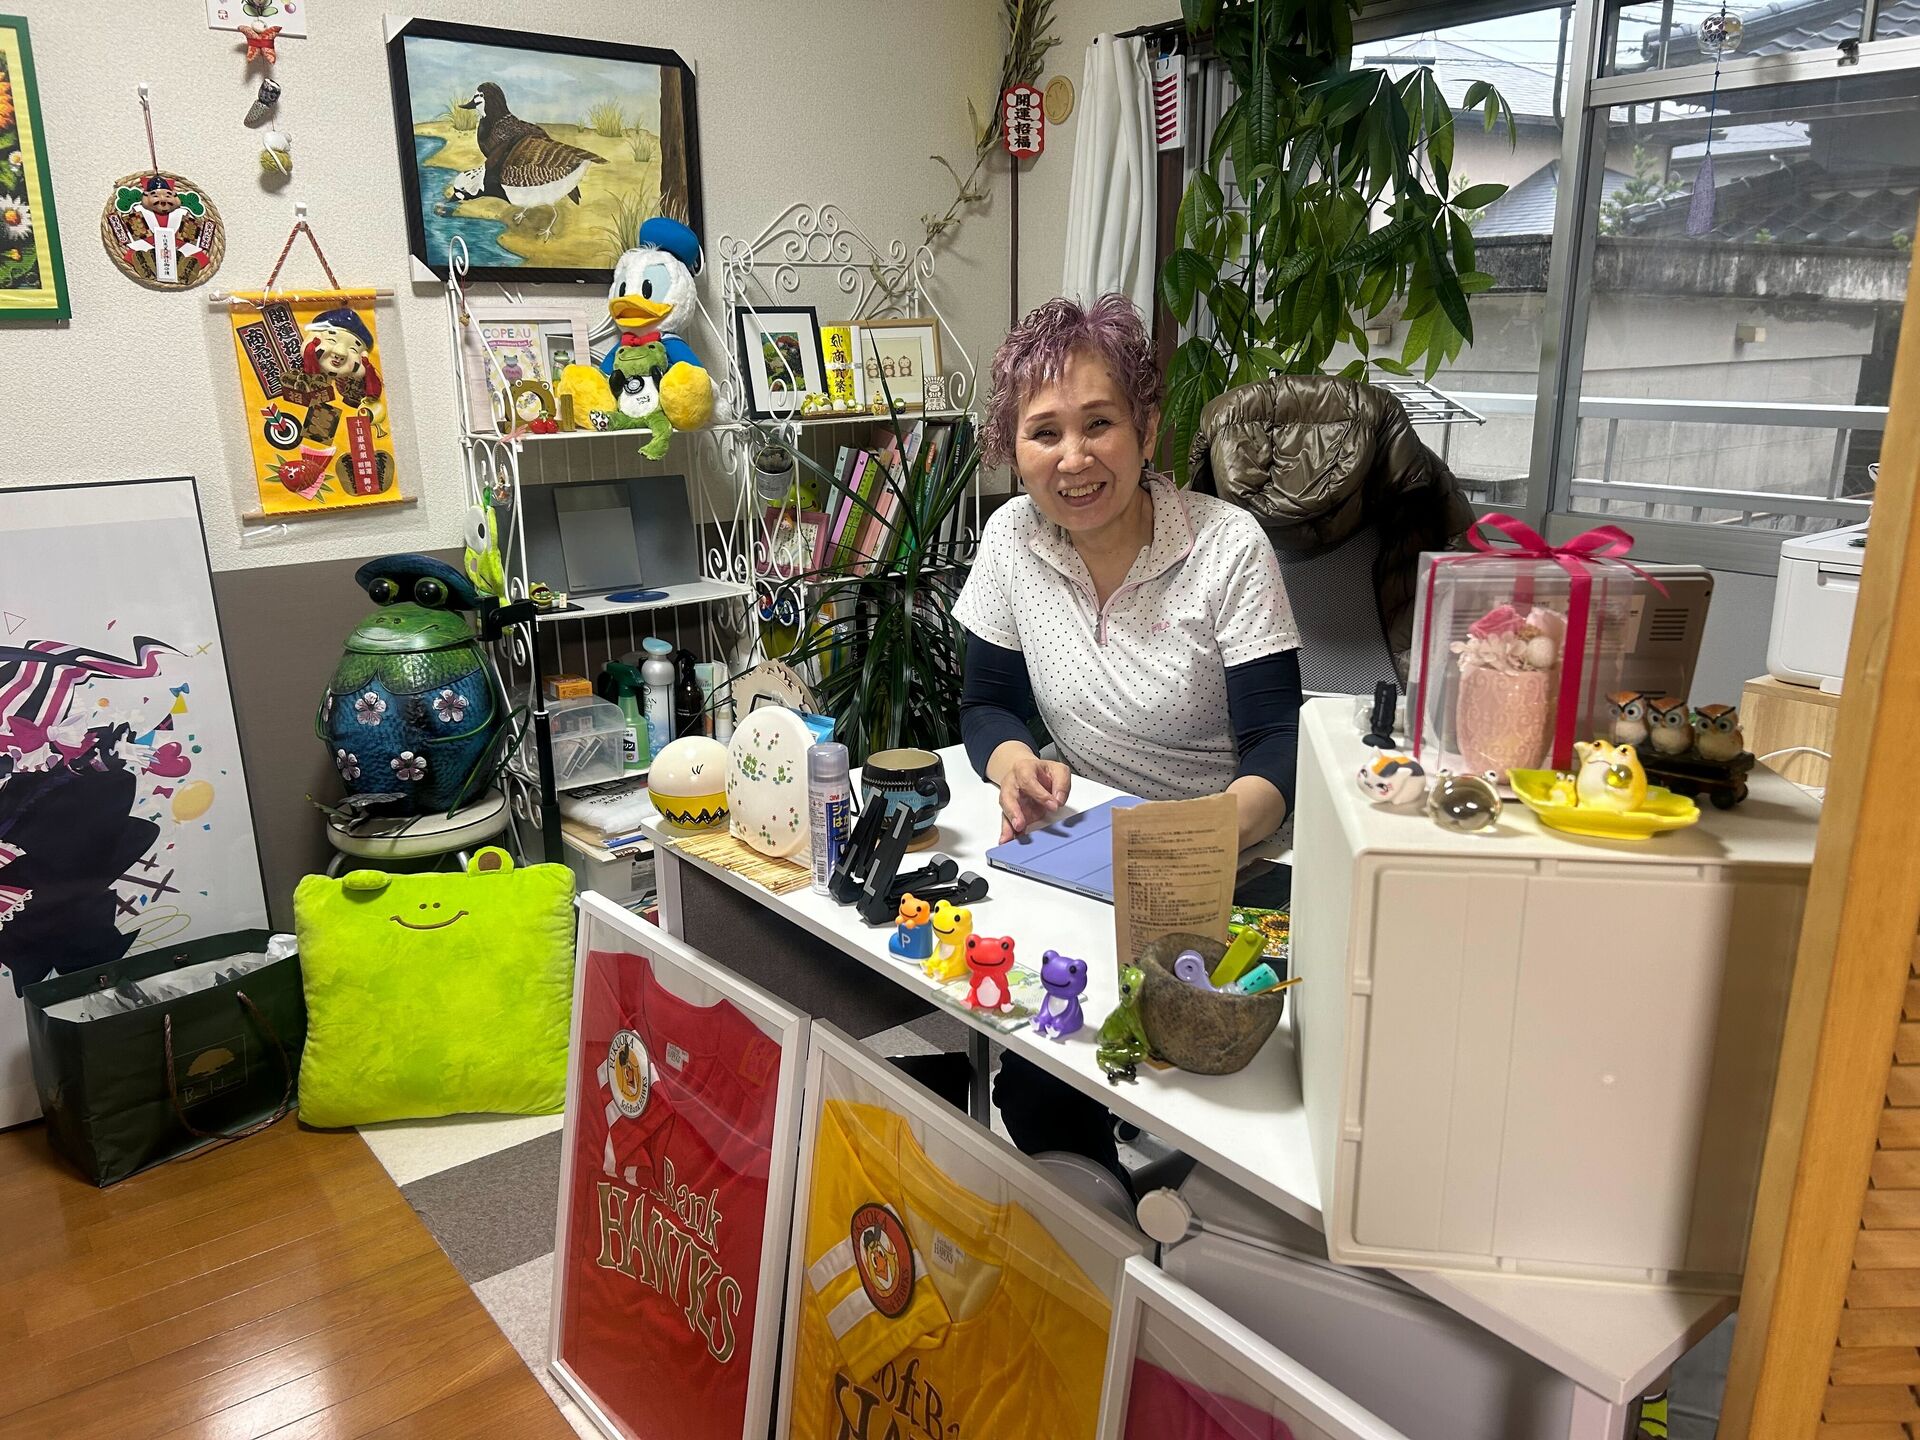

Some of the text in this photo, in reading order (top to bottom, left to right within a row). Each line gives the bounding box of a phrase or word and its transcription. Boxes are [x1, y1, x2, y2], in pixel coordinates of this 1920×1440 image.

[1014, 93, 1034, 148] 開運招福
[482, 328, 531, 339] COPEAU
[901, 933, 911, 948] P
[609, 1034, 634, 1069] FUKUOKA
[650, 1155, 723, 1254] Bank
[596, 1181, 742, 1364] HAWKS
[872, 1358, 960, 1440] oftBa
